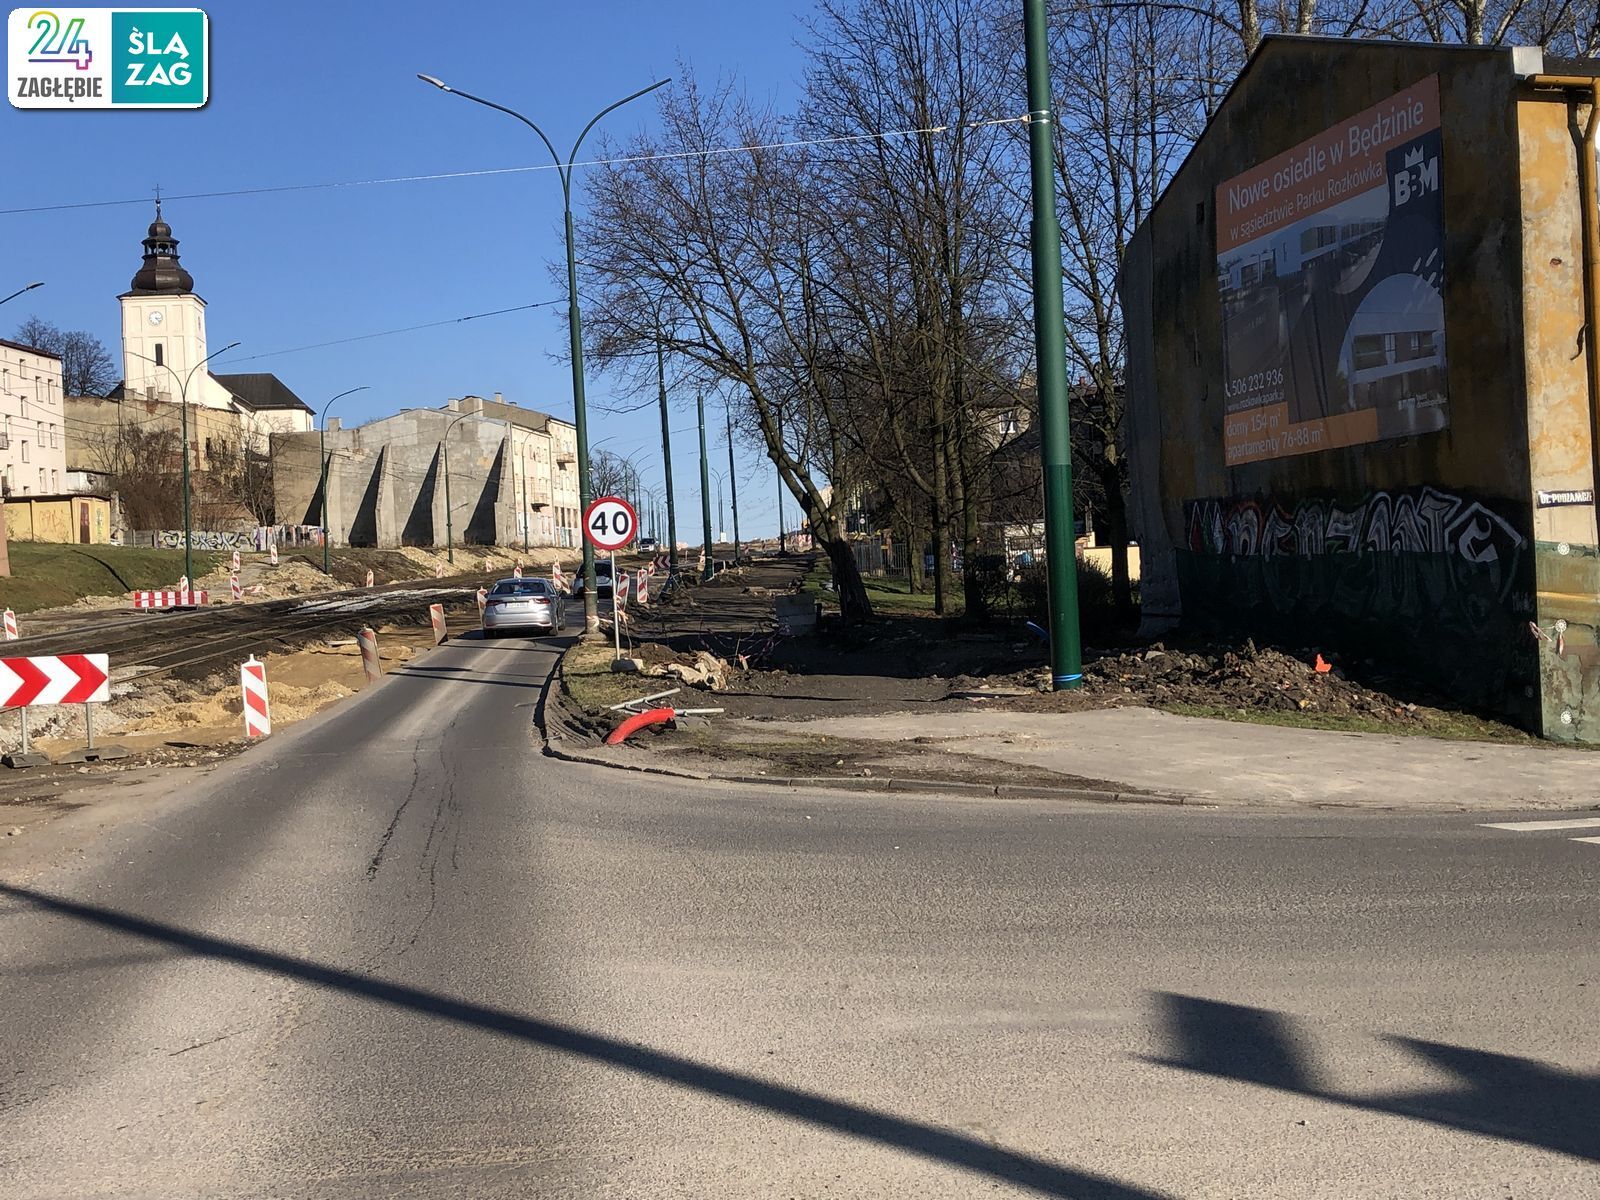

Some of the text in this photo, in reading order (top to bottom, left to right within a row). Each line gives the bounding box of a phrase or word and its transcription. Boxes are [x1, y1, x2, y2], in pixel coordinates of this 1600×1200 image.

[1228, 97, 1424, 214] Nowe osiedle w Będzinie
[1229, 160, 1383, 241] w sąsiedztwie Parku Rozkówka
[1231, 367, 1284, 396] 506 232 936
[1226, 419, 1249, 437] domy
[1251, 414, 1268, 432] 154
[1227, 437, 1280, 458] apartamenty
[1282, 427, 1309, 449] 76-88
[591, 511, 629, 536] 40
